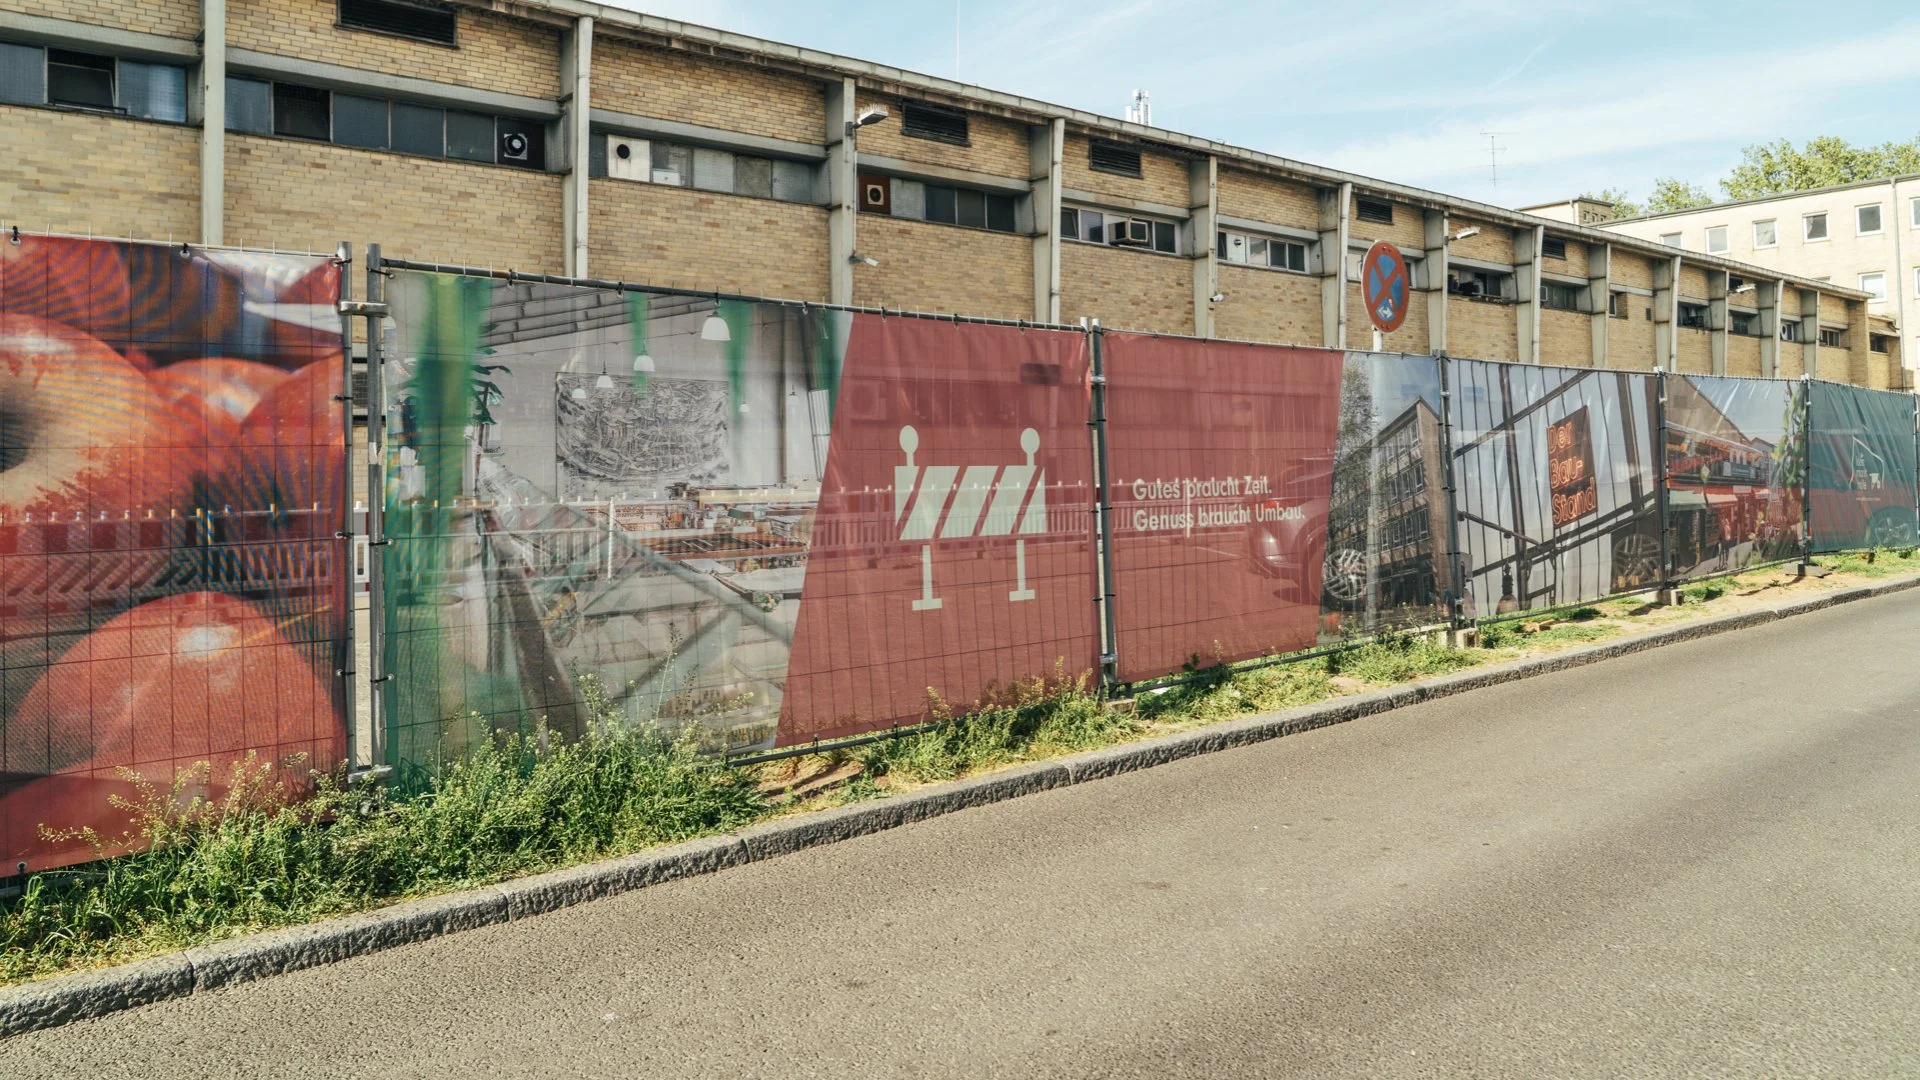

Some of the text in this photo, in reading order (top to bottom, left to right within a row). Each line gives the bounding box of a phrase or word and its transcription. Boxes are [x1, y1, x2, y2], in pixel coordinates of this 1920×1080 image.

[1547, 421, 1573, 454] Der
[1132, 475, 1272, 500] Gutes braucht Zeit.
[1549, 455, 1584, 489] Bau-
[1133, 501, 1306, 532] Genuss braucht Umbau.
[1551, 475, 1598, 525] Stand
